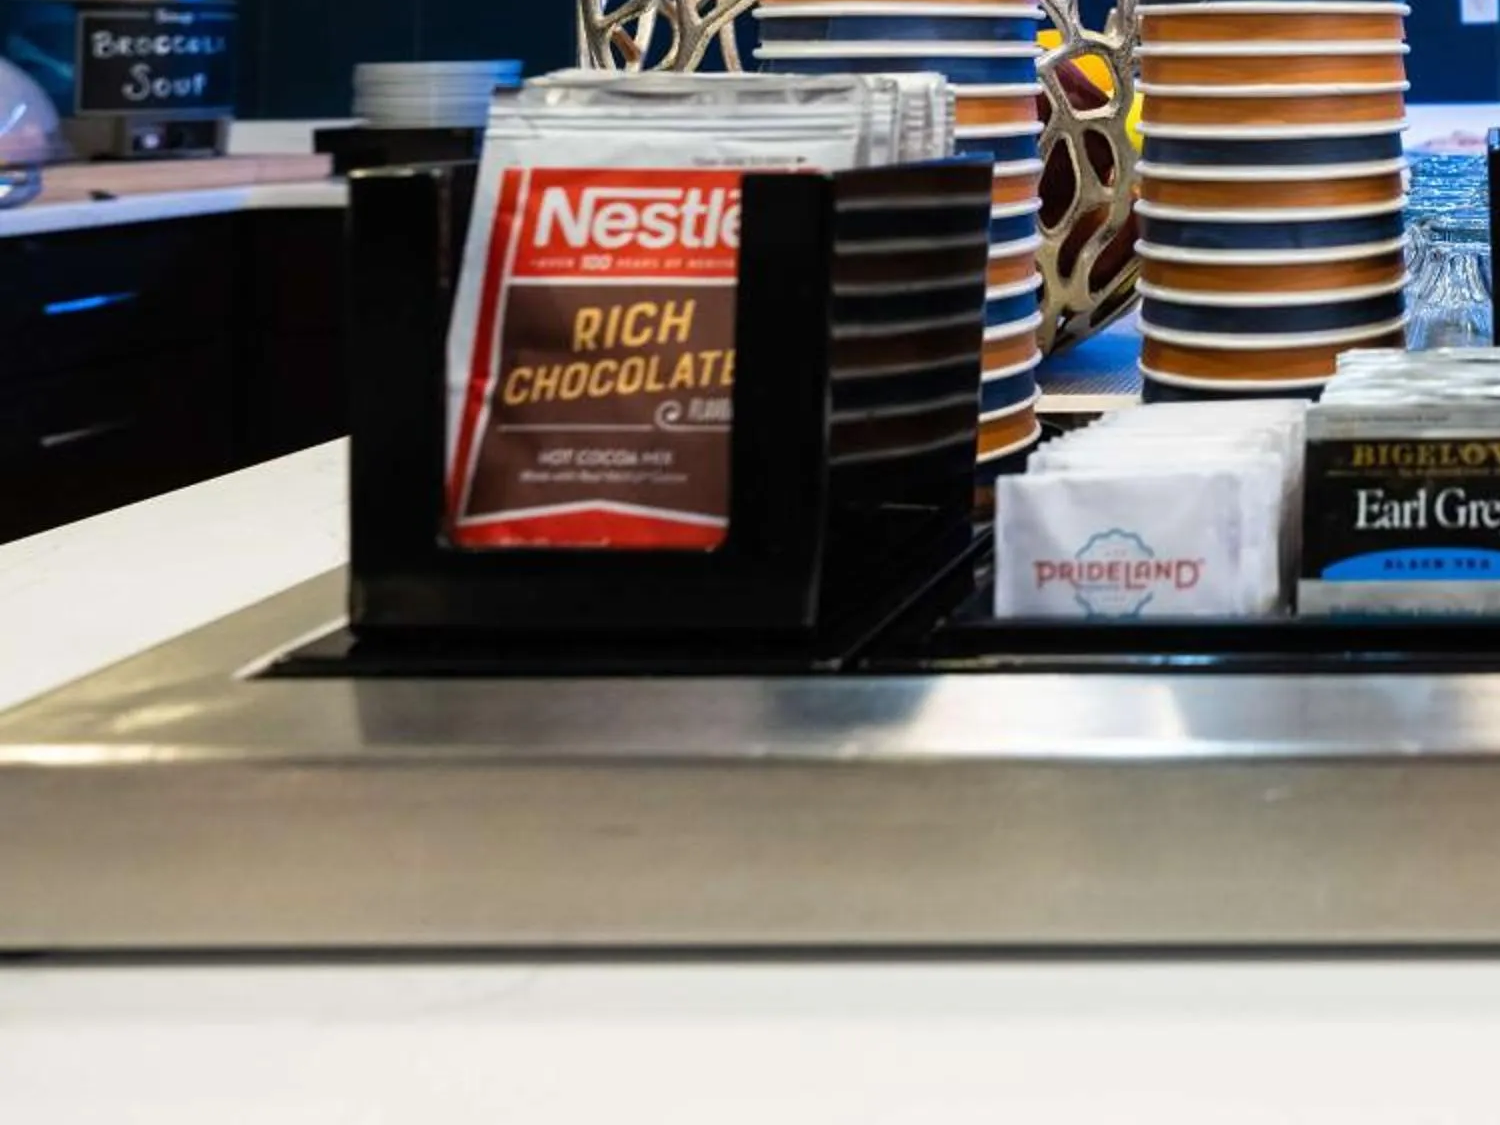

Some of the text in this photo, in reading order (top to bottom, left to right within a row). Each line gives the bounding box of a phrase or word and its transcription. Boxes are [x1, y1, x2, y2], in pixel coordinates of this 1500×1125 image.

[573, 299, 697, 352] RICH
[1355, 488, 1427, 530] Earl
[1033, 560, 1201, 590] PRIDELAND
